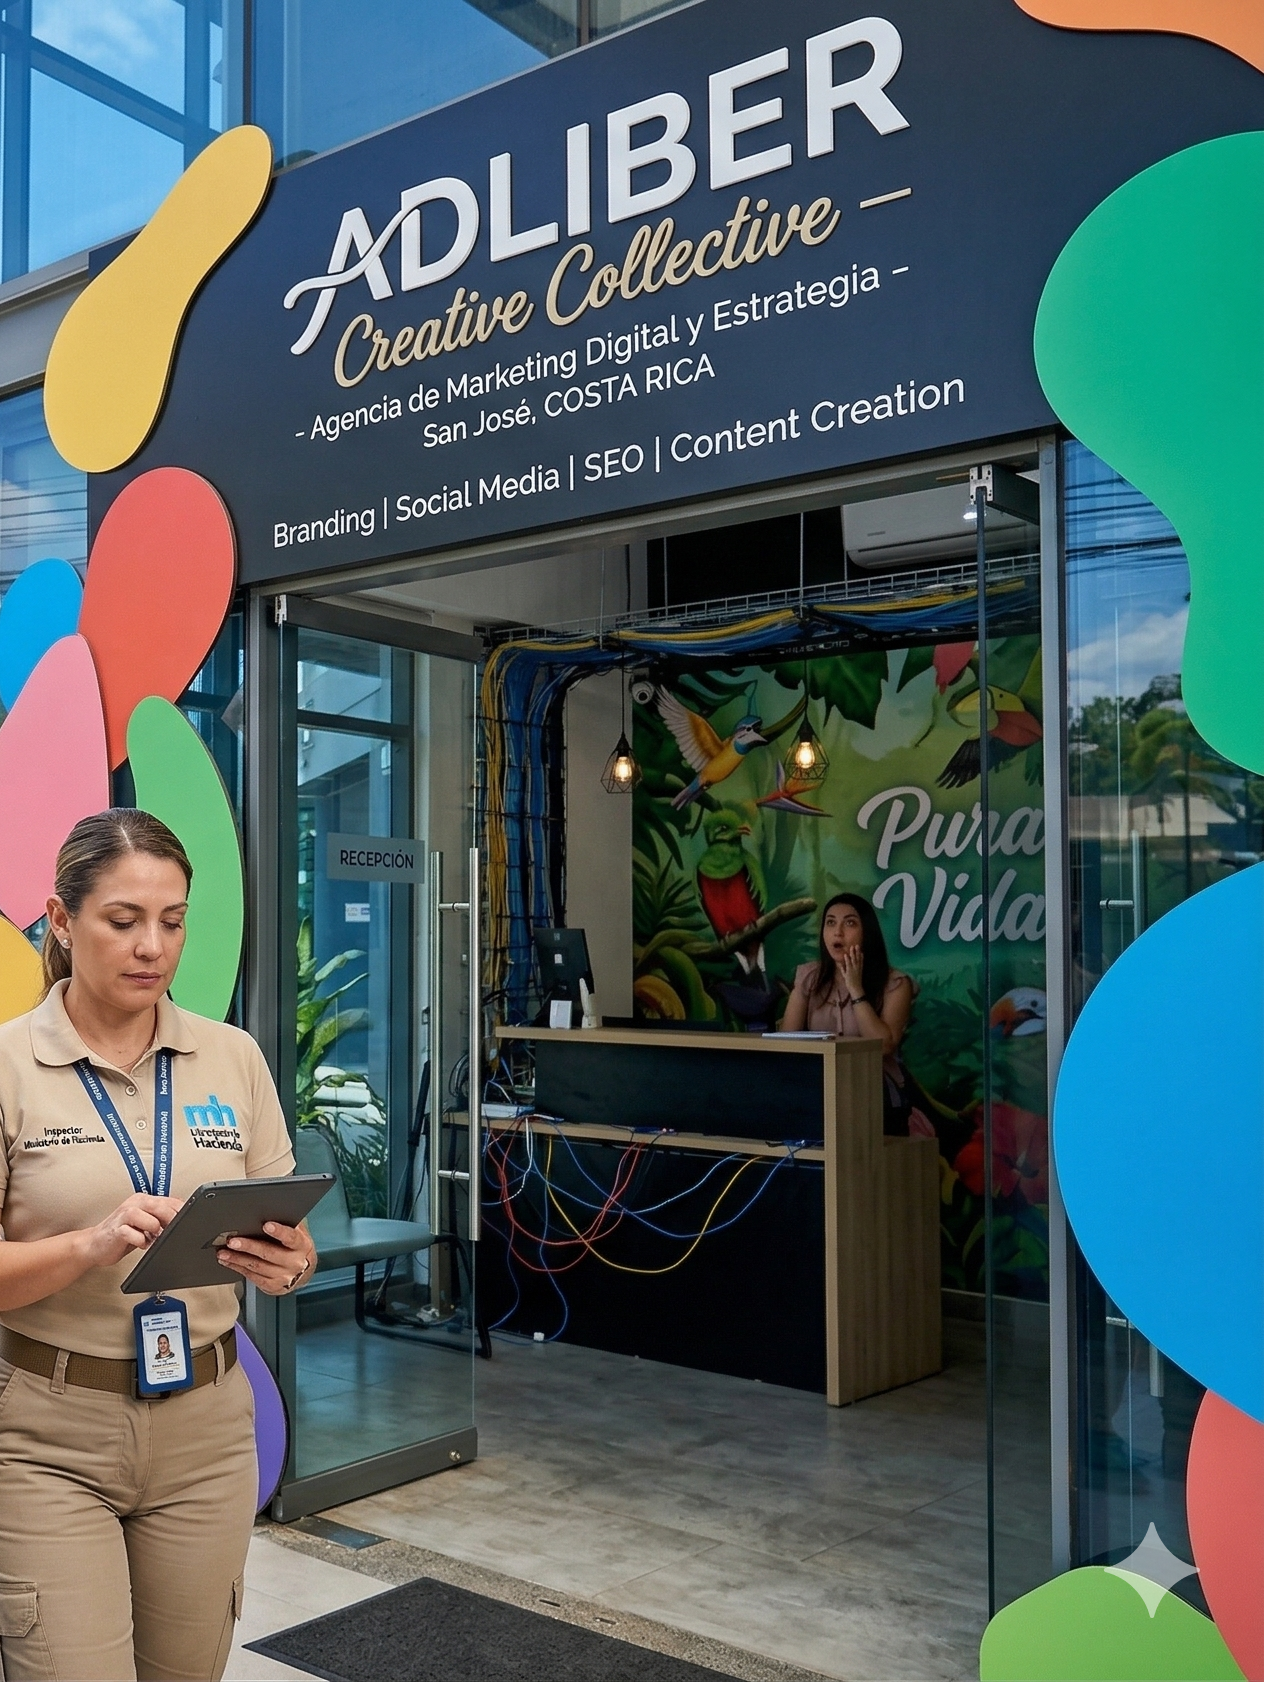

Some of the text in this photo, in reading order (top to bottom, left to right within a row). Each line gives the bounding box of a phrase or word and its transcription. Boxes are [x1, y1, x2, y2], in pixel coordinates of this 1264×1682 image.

[284, 17, 911, 355] ADLIBER
[311, 398, 403, 442] Agencia
[408, 383, 440, 413] de
[447, 349, 577, 404] Marketing
[586, 314, 680, 366] Digital
[685, 313, 705, 347] y
[713, 263, 881, 332] Estrategia
[334, 287, 535, 388] Creative
[545, 196, 841, 326] Collective
[274, 508, 375, 549] Branding
[395, 480, 473, 522] Social
[479, 465, 560, 505] Media
[584, 444, 644, 482] SEO
[670, 408, 801, 463] Content
[810, 378, 964, 432] Creation
[423, 353, 716, 448] San José, COSTA RICA
[340, 849, 414, 869] RECEPCIÓN
[857, 786, 1045, 869] Pura
[872, 866, 1046, 948] Vida
